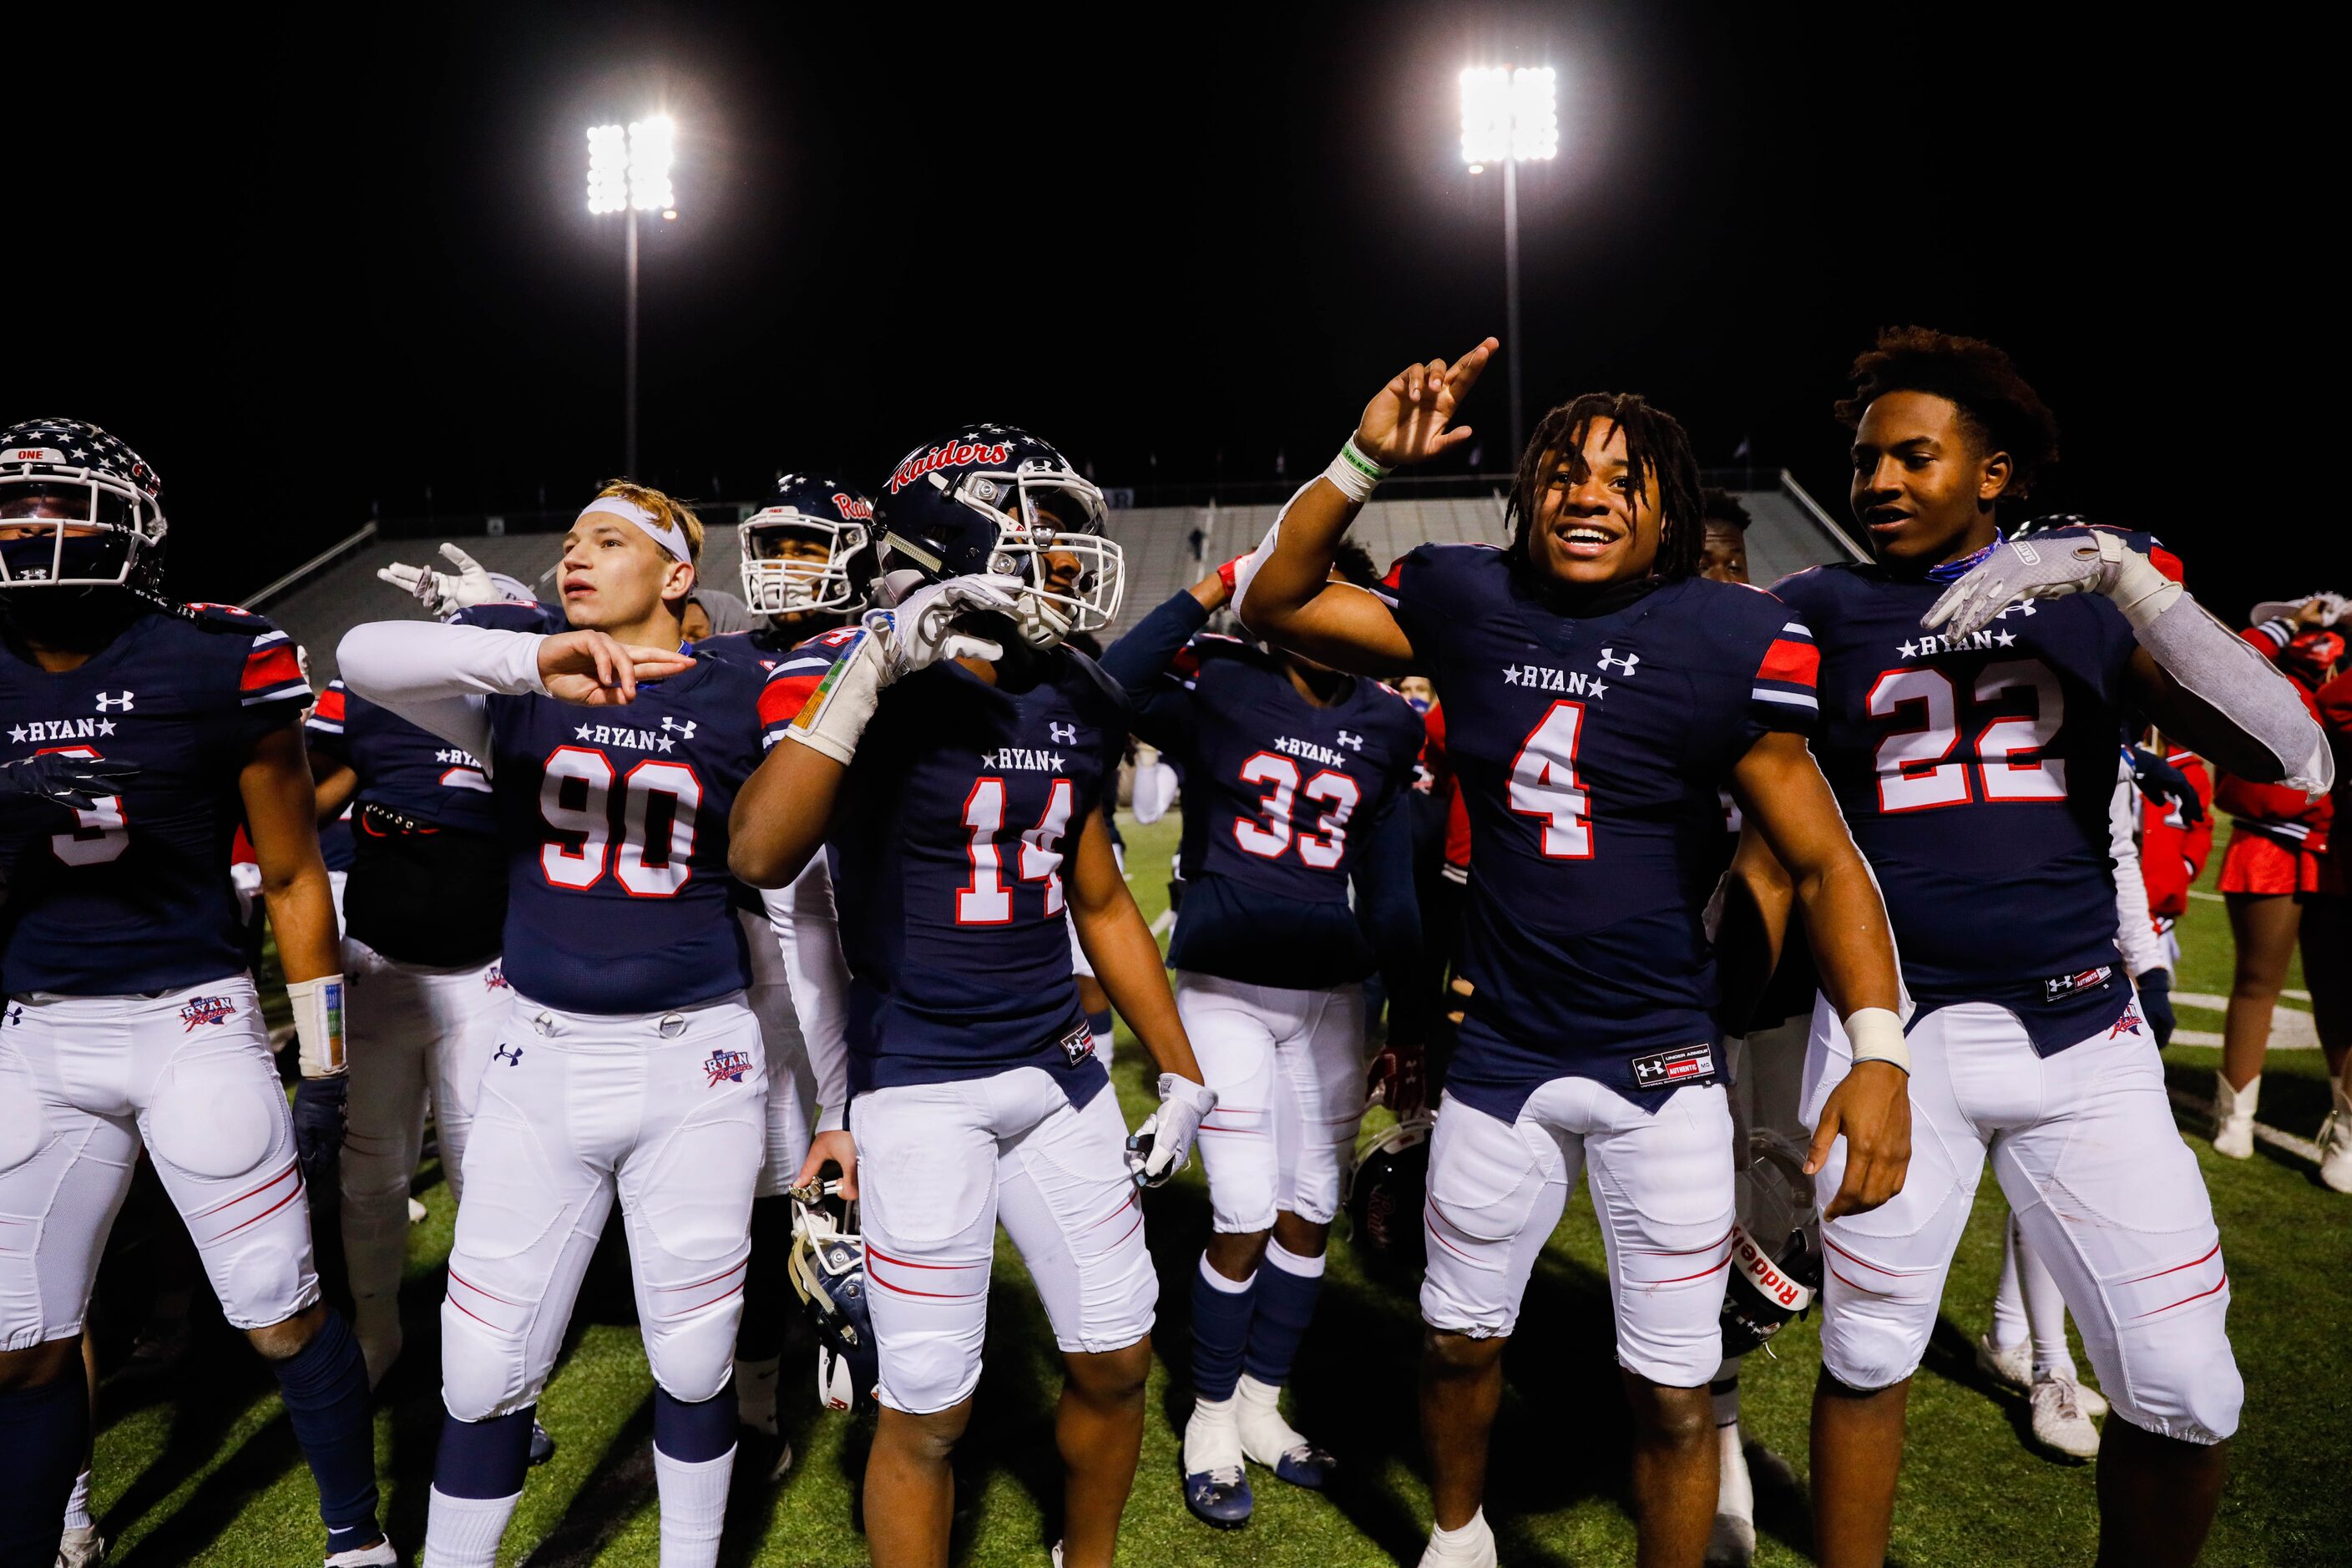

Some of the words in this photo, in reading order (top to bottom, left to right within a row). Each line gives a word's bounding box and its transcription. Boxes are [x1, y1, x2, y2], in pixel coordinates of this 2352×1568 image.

[18, 450, 44, 460] ONE
[891, 440, 1008, 494] Raiders
[832, 493, 873, 521] Rai
[1920, 630, 1992, 655] RYAN
[1521, 665, 1588, 695] RYAN
[28, 718, 94, 741] RYAN
[593, 725, 656, 751] RYAN
[1865, 658, 2068, 814] 22
[449, 749, 482, 768] RYA
[999, 748, 1049, 771] RYAN
[1287, 737, 1334, 765] RYAN
[1505, 699, 1595, 859] 4
[539, 745, 704, 898] 90
[1232, 751, 1362, 869] 33
[955, 777, 1075, 925] 14
[182, 998, 233, 1020] RYAN
[705, 1052, 749, 1074] RYAN
[1669, 1064, 1697, 1075] AUTHENTIC
